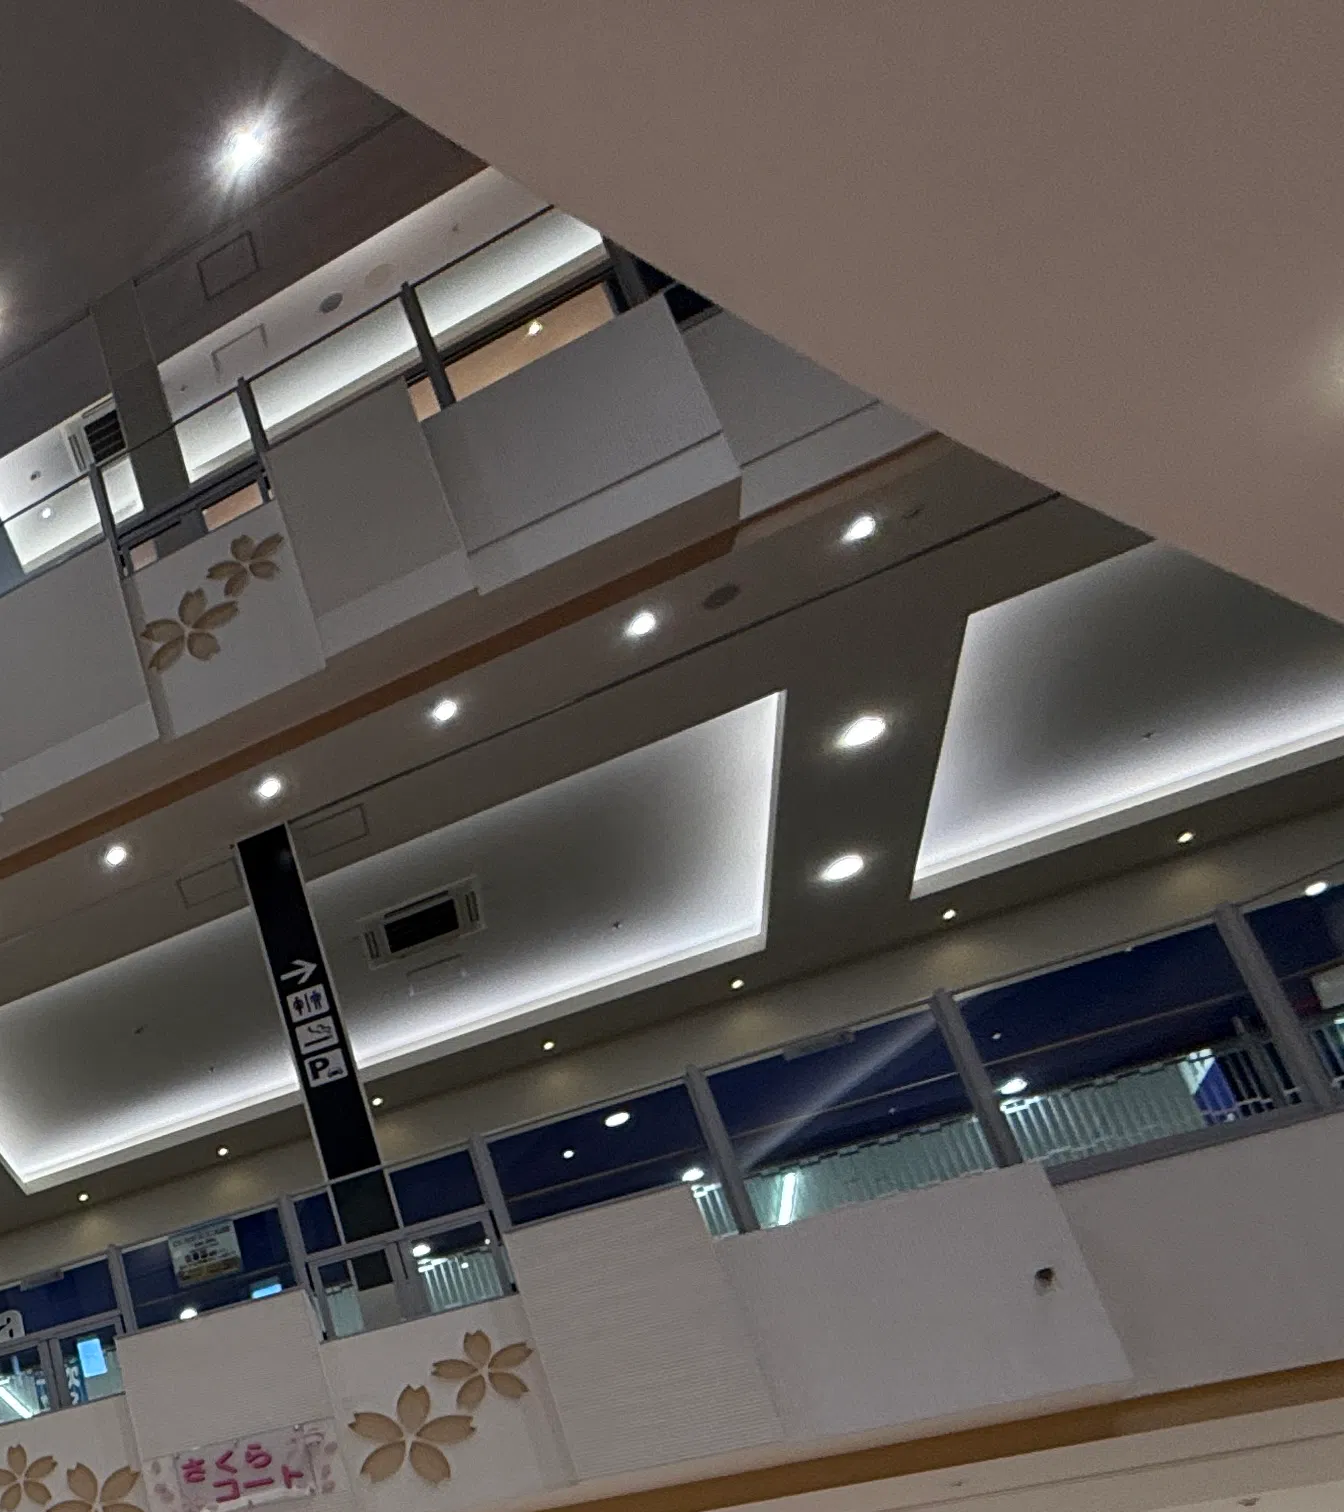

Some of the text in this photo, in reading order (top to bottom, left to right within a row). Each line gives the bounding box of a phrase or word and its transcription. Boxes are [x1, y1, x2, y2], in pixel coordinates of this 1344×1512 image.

[180, 1443, 274, 1484] さくら
[212, 1464, 305, 1503] コート
